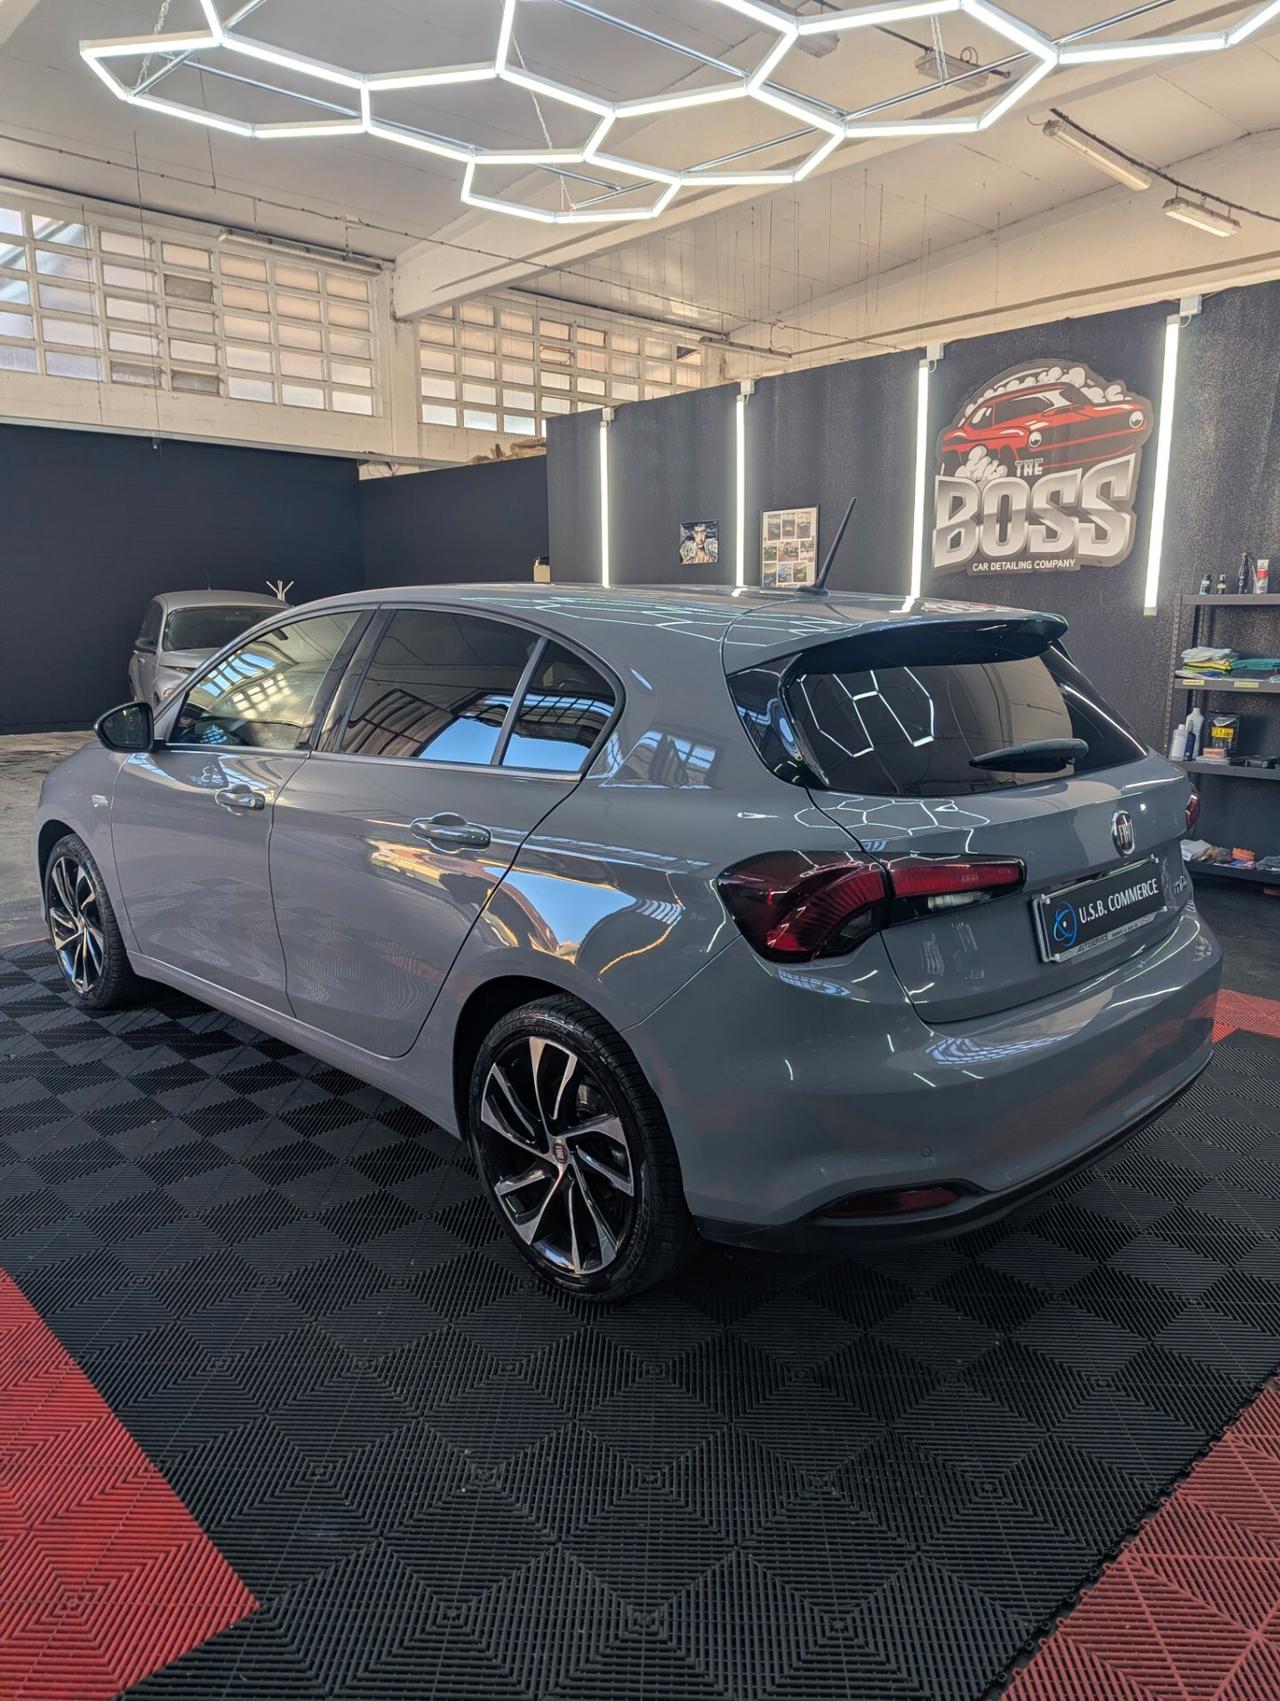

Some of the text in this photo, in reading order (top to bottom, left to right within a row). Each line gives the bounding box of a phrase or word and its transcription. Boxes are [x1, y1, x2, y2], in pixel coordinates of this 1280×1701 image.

[1014, 457, 1044, 477] THE
[932, 453, 1137, 568] BOSS
[972, 558, 1077, 572] CAR DETAILING COMPANY
[1078, 900, 1108, 924] U.S.B.
[1108, 878, 1159, 912] COMMERCE
